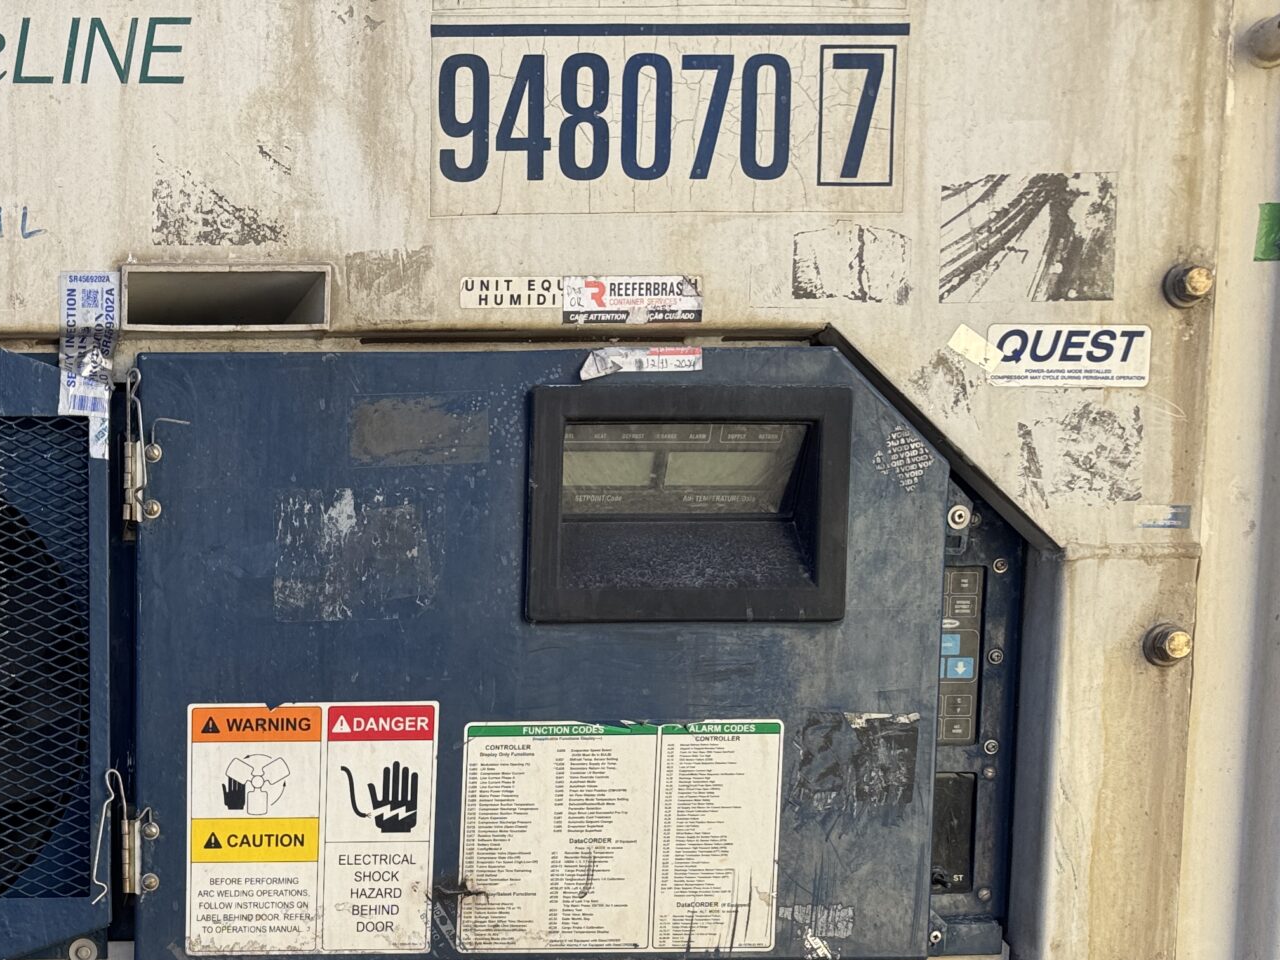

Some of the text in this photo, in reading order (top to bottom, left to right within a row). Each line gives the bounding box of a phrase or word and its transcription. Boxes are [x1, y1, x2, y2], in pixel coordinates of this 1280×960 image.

[438, 52, 886, 183] 948070 7
[465, 280, 513, 292] UNIT
[609, 282, 683, 297] REEFERBRAS
[479, 294, 563, 306] HUMIDI
[996, 329, 1146, 364] QUEST
[226, 717, 311, 732] WARNING
[352, 716, 429, 732] DANGER
[688, 724, 756, 733] ALARM CODES
[522, 725, 605, 735] FUNCTION CODES
[226, 833, 305, 848] CAUTION
[338, 854, 416, 866] ELECTRICAL
[209, 876, 299, 885] BEFORE PERFORMING
[354, 871, 399, 882] SHOCK
[197, 890, 216, 898] ARC
[217, 889, 254, 898] WELDING
[350, 888, 402, 899] HAZARD
[198, 901, 309, 910] FOLLOW INSTRUCTIONS ON
[351, 904, 400, 916] BEHIND
[196, 913, 222, 922] LABEL
[223, 913, 254, 922] BEHIND
[283, 913, 311, 921] REFER
[202, 925, 214, 934] TO
[215, 925, 268, 934] OPERATIONS
[356, 921, 395, 932] DOOR
